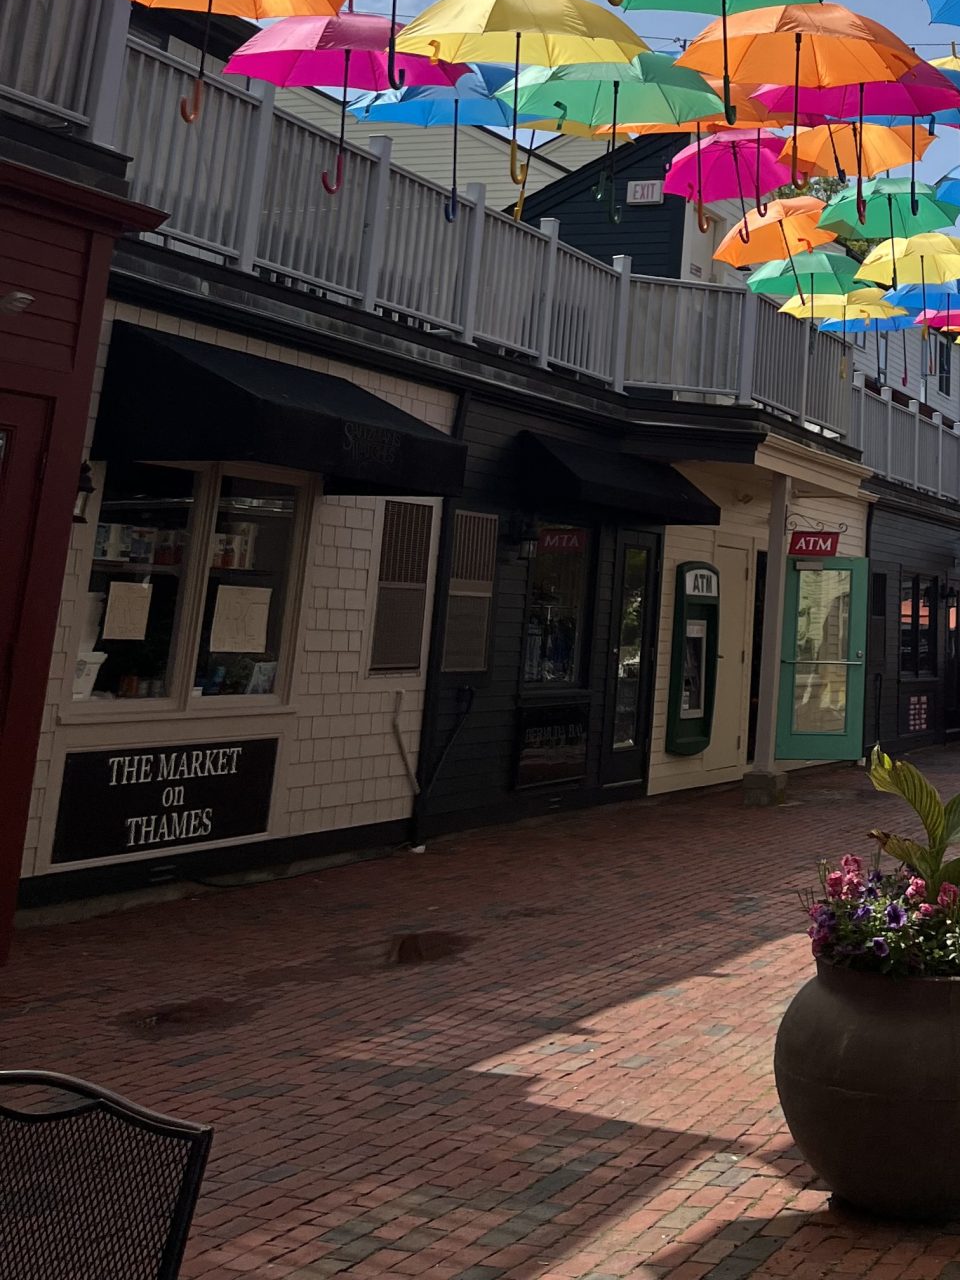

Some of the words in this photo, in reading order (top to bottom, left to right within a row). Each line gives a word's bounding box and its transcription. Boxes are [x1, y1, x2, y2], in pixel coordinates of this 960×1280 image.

[633, 183, 657, 200] EXIT
[795, 537, 832, 551] ATM
[693, 573, 713, 594] ATM
[108, 754, 153, 786] THE
[156, 747, 243, 781] MARKET
[162, 786, 184, 807] on
[126, 808, 213, 847] THAMES
